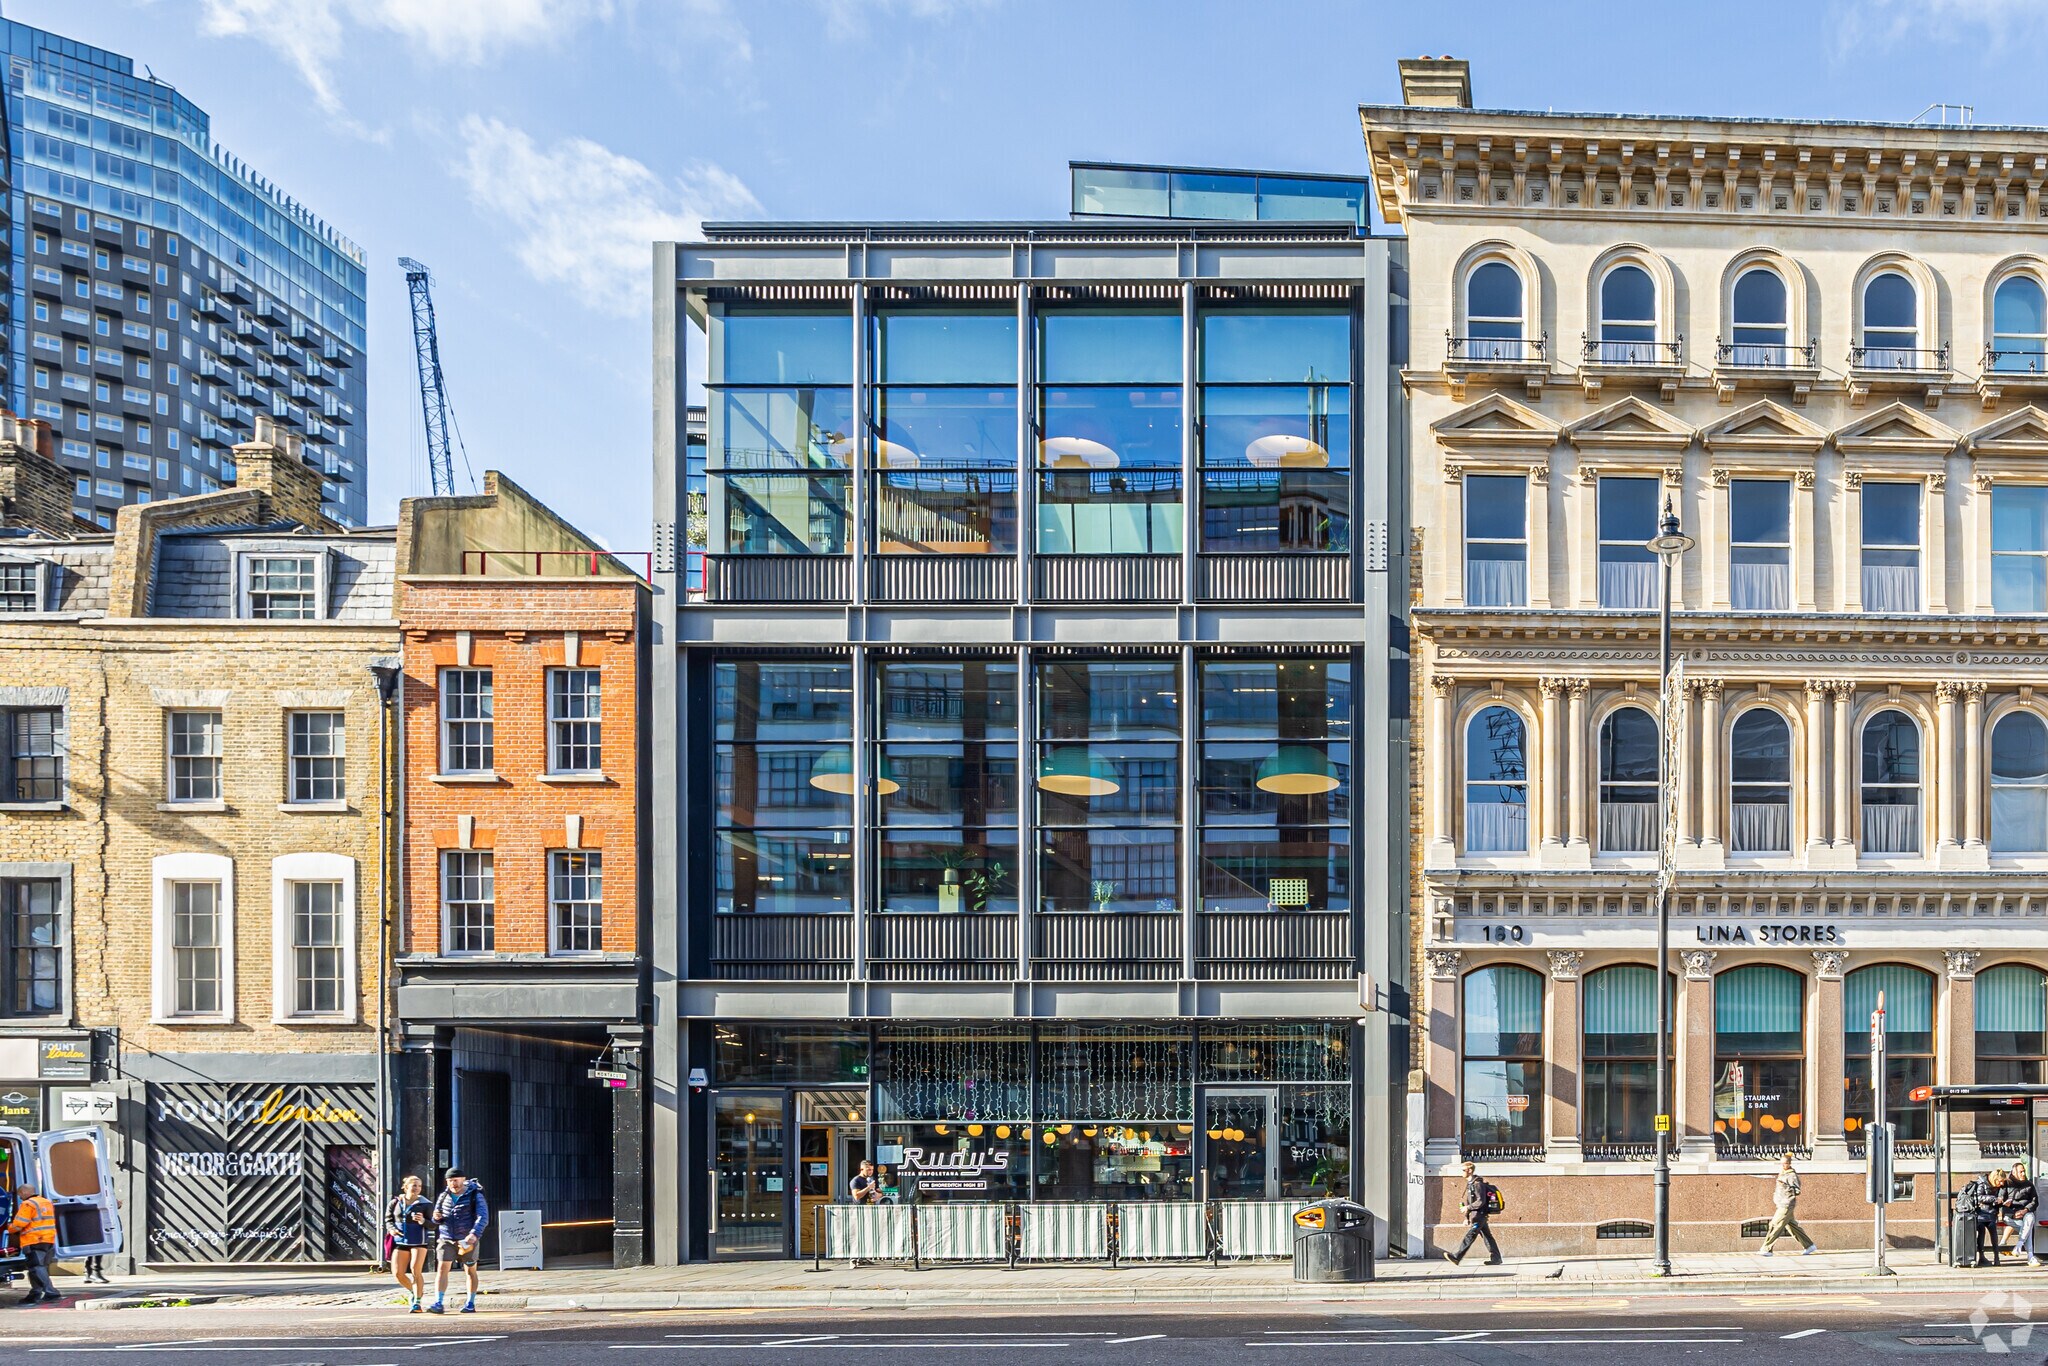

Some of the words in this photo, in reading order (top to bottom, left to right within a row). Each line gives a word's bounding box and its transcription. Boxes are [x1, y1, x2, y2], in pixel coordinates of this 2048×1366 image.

[1483, 925, 1523, 942] 180
[1696, 925, 1746, 941] LINA
[1759, 925, 1837, 941] STORES
[41, 1043, 76, 1051] FOUNT
[158, 1100, 265, 1122] FOUNT
[1657, 1117, 1667, 1129] H
[897, 1147, 1009, 1176] Rudy's
